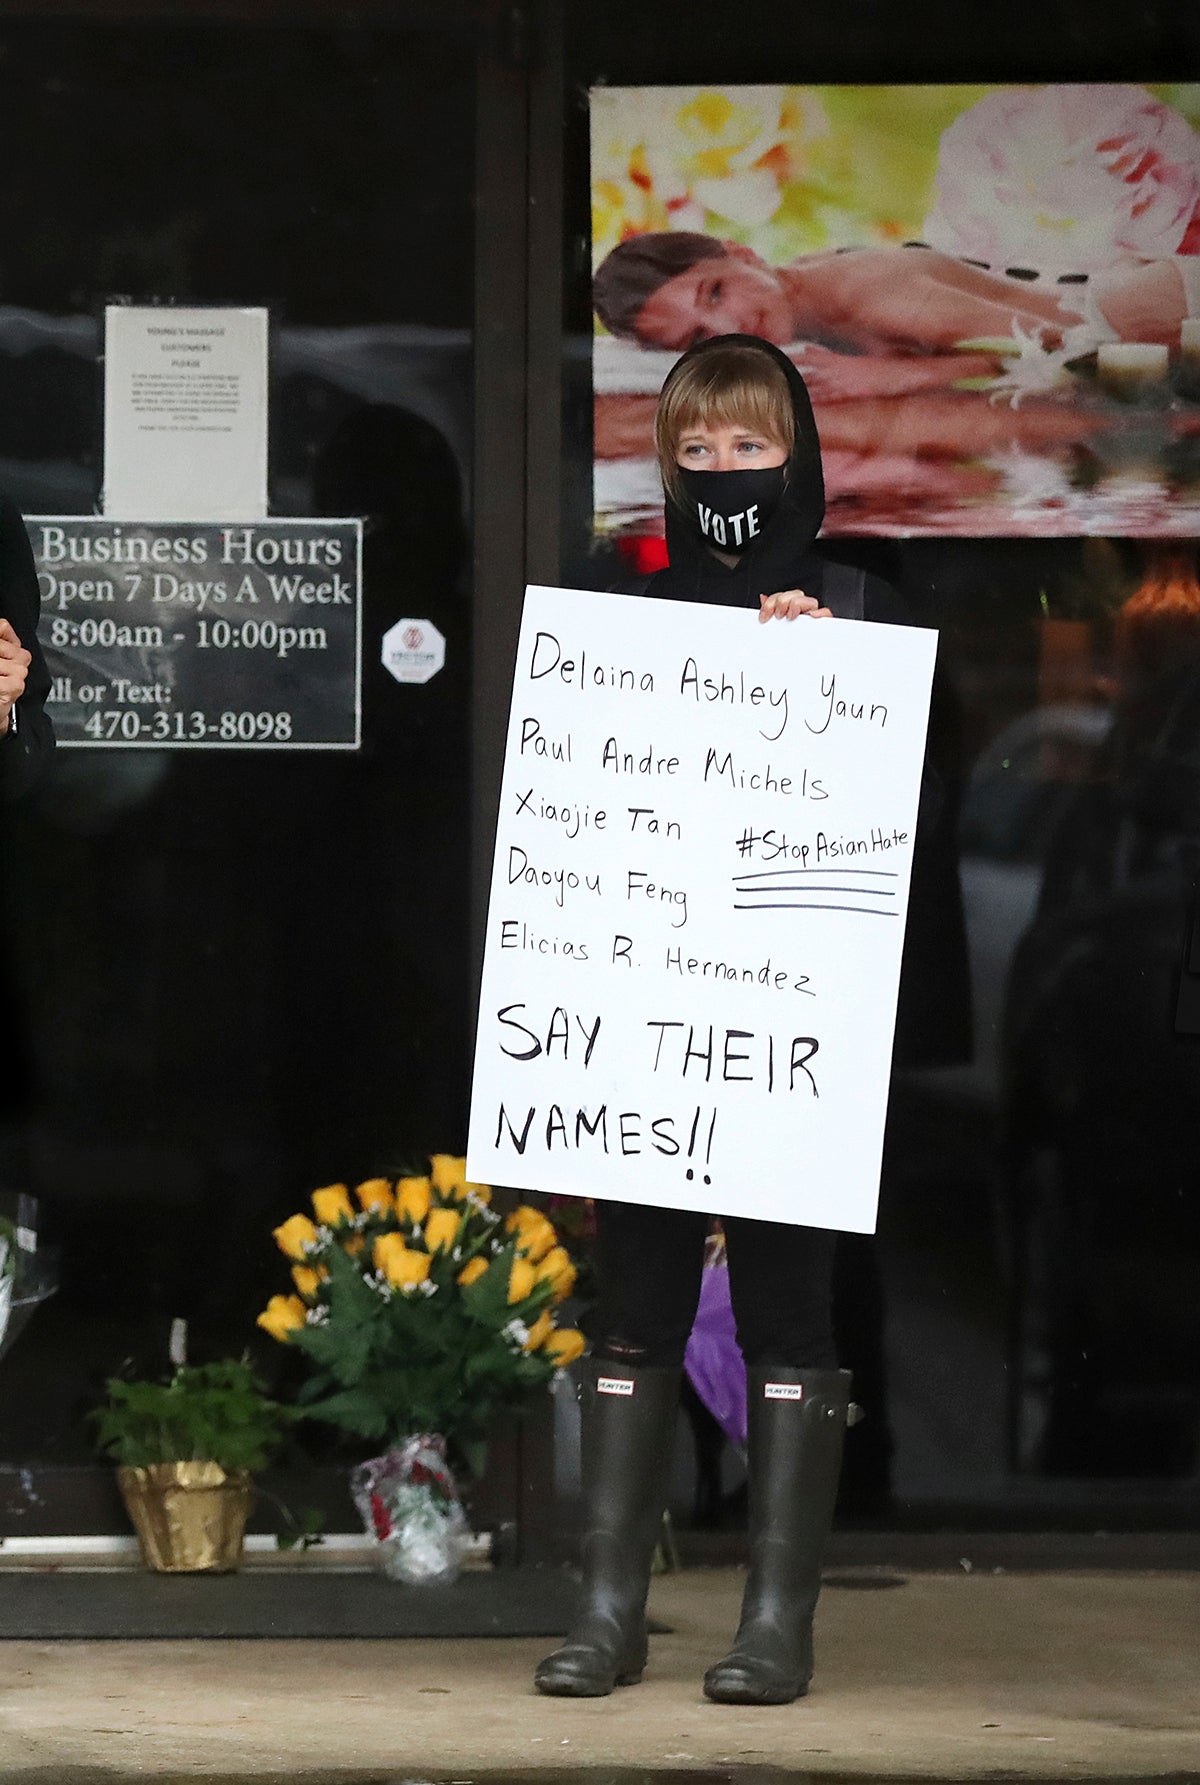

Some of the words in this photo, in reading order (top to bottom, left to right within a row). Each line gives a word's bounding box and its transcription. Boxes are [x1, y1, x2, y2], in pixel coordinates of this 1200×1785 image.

[39, 526, 208, 564] Business
[221, 528, 343, 566] Hours
[698, 502, 761, 547] VOTE
[37, 572, 115, 610] Open
[124, 574, 142, 602] 7
[152, 573, 228, 611] Days
[234, 574, 259, 603] A
[265, 573, 353, 604] Week
[51, 618, 163, 648] 8:00am
[197, 619, 328, 658] 10:00pm
[78, 684, 106, 703] or
[111, 679, 172, 703] Text:
[529, 631, 654, 692] Delaina
[680, 657, 788, 741] Ashley
[804, 674, 889, 735] Yaun
[84, 710, 293, 741] 470-313-8098
[520, 717, 572, 763] Paul
[602, 737, 680, 775] Andre
[704, 747, 830, 801] Michels
[515, 788, 607, 838] Xiaojie
[627, 807, 682, 840] Tan
[508, 846, 602, 908] Daoyou
[627, 870, 688, 929] Feng
[501, 920, 589, 961] Elicias
[612, 935, 642, 969] R.
[666, 946, 817, 997] Hernandez
[496, 1003, 601, 1069] SAY
[646, 1021, 821, 1099] THEIR
[494, 1102, 718, 1187] NAMES!!
